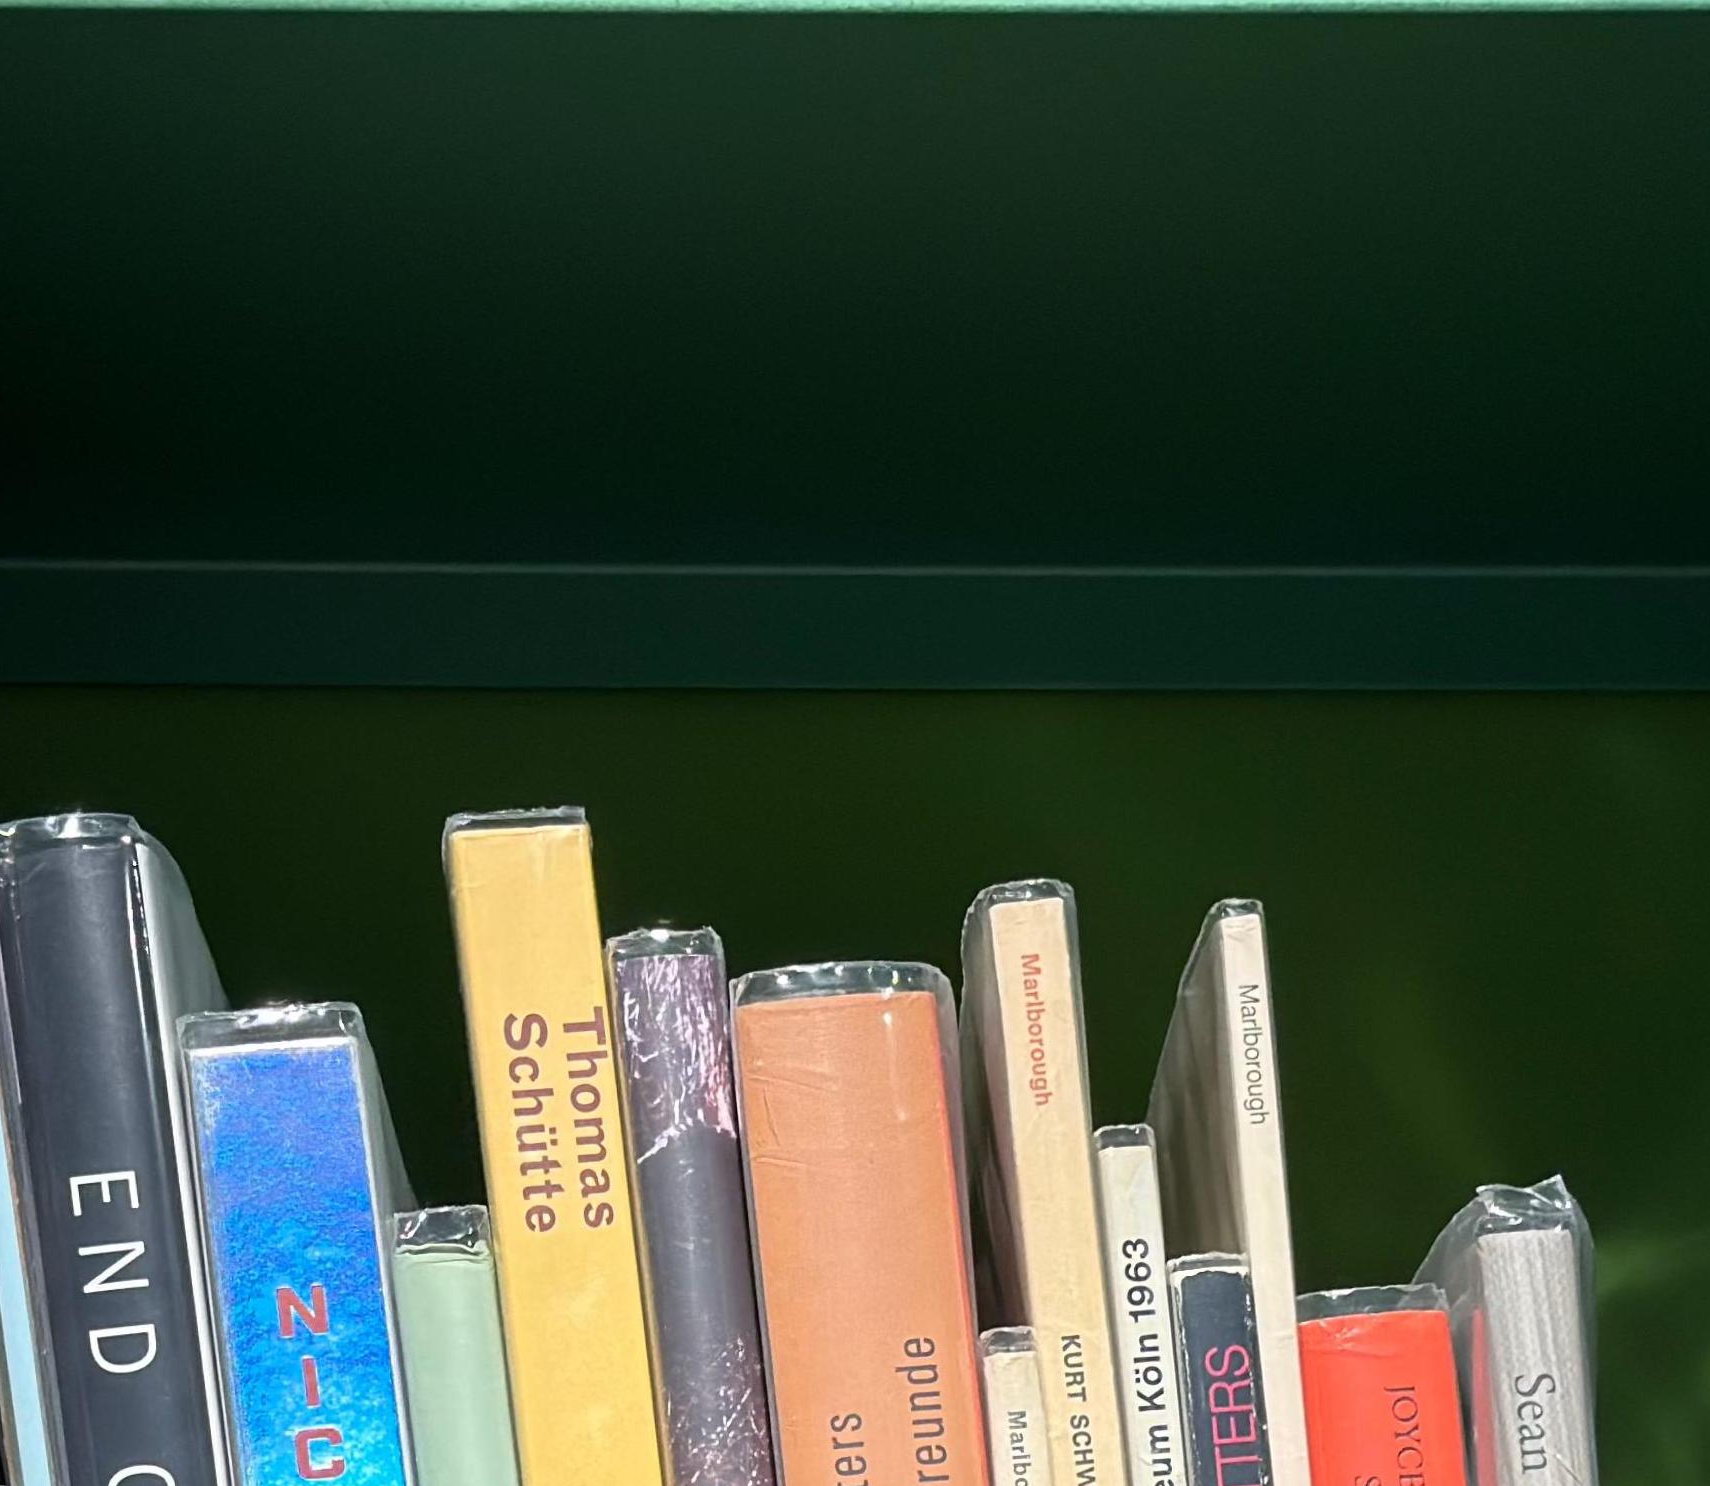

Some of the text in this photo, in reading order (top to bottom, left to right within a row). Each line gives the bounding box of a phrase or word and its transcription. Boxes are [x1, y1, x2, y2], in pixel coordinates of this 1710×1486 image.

[1021, 953, 1052, 1105] Marlborough
[1239, 984, 1269, 1123] Marlborough
[504, 1013, 564, 1231] Schütte
[562, 1001, 613, 1227] Thomas
[69, 1170, 156, 1372] END
[1122, 1238, 1155, 1322] 1963
[1061, 1335, 1086, 1401] KURT
[1133, 1334, 1165, 1411] Köln
[1512, 1372, 1562, 1474] Sean
